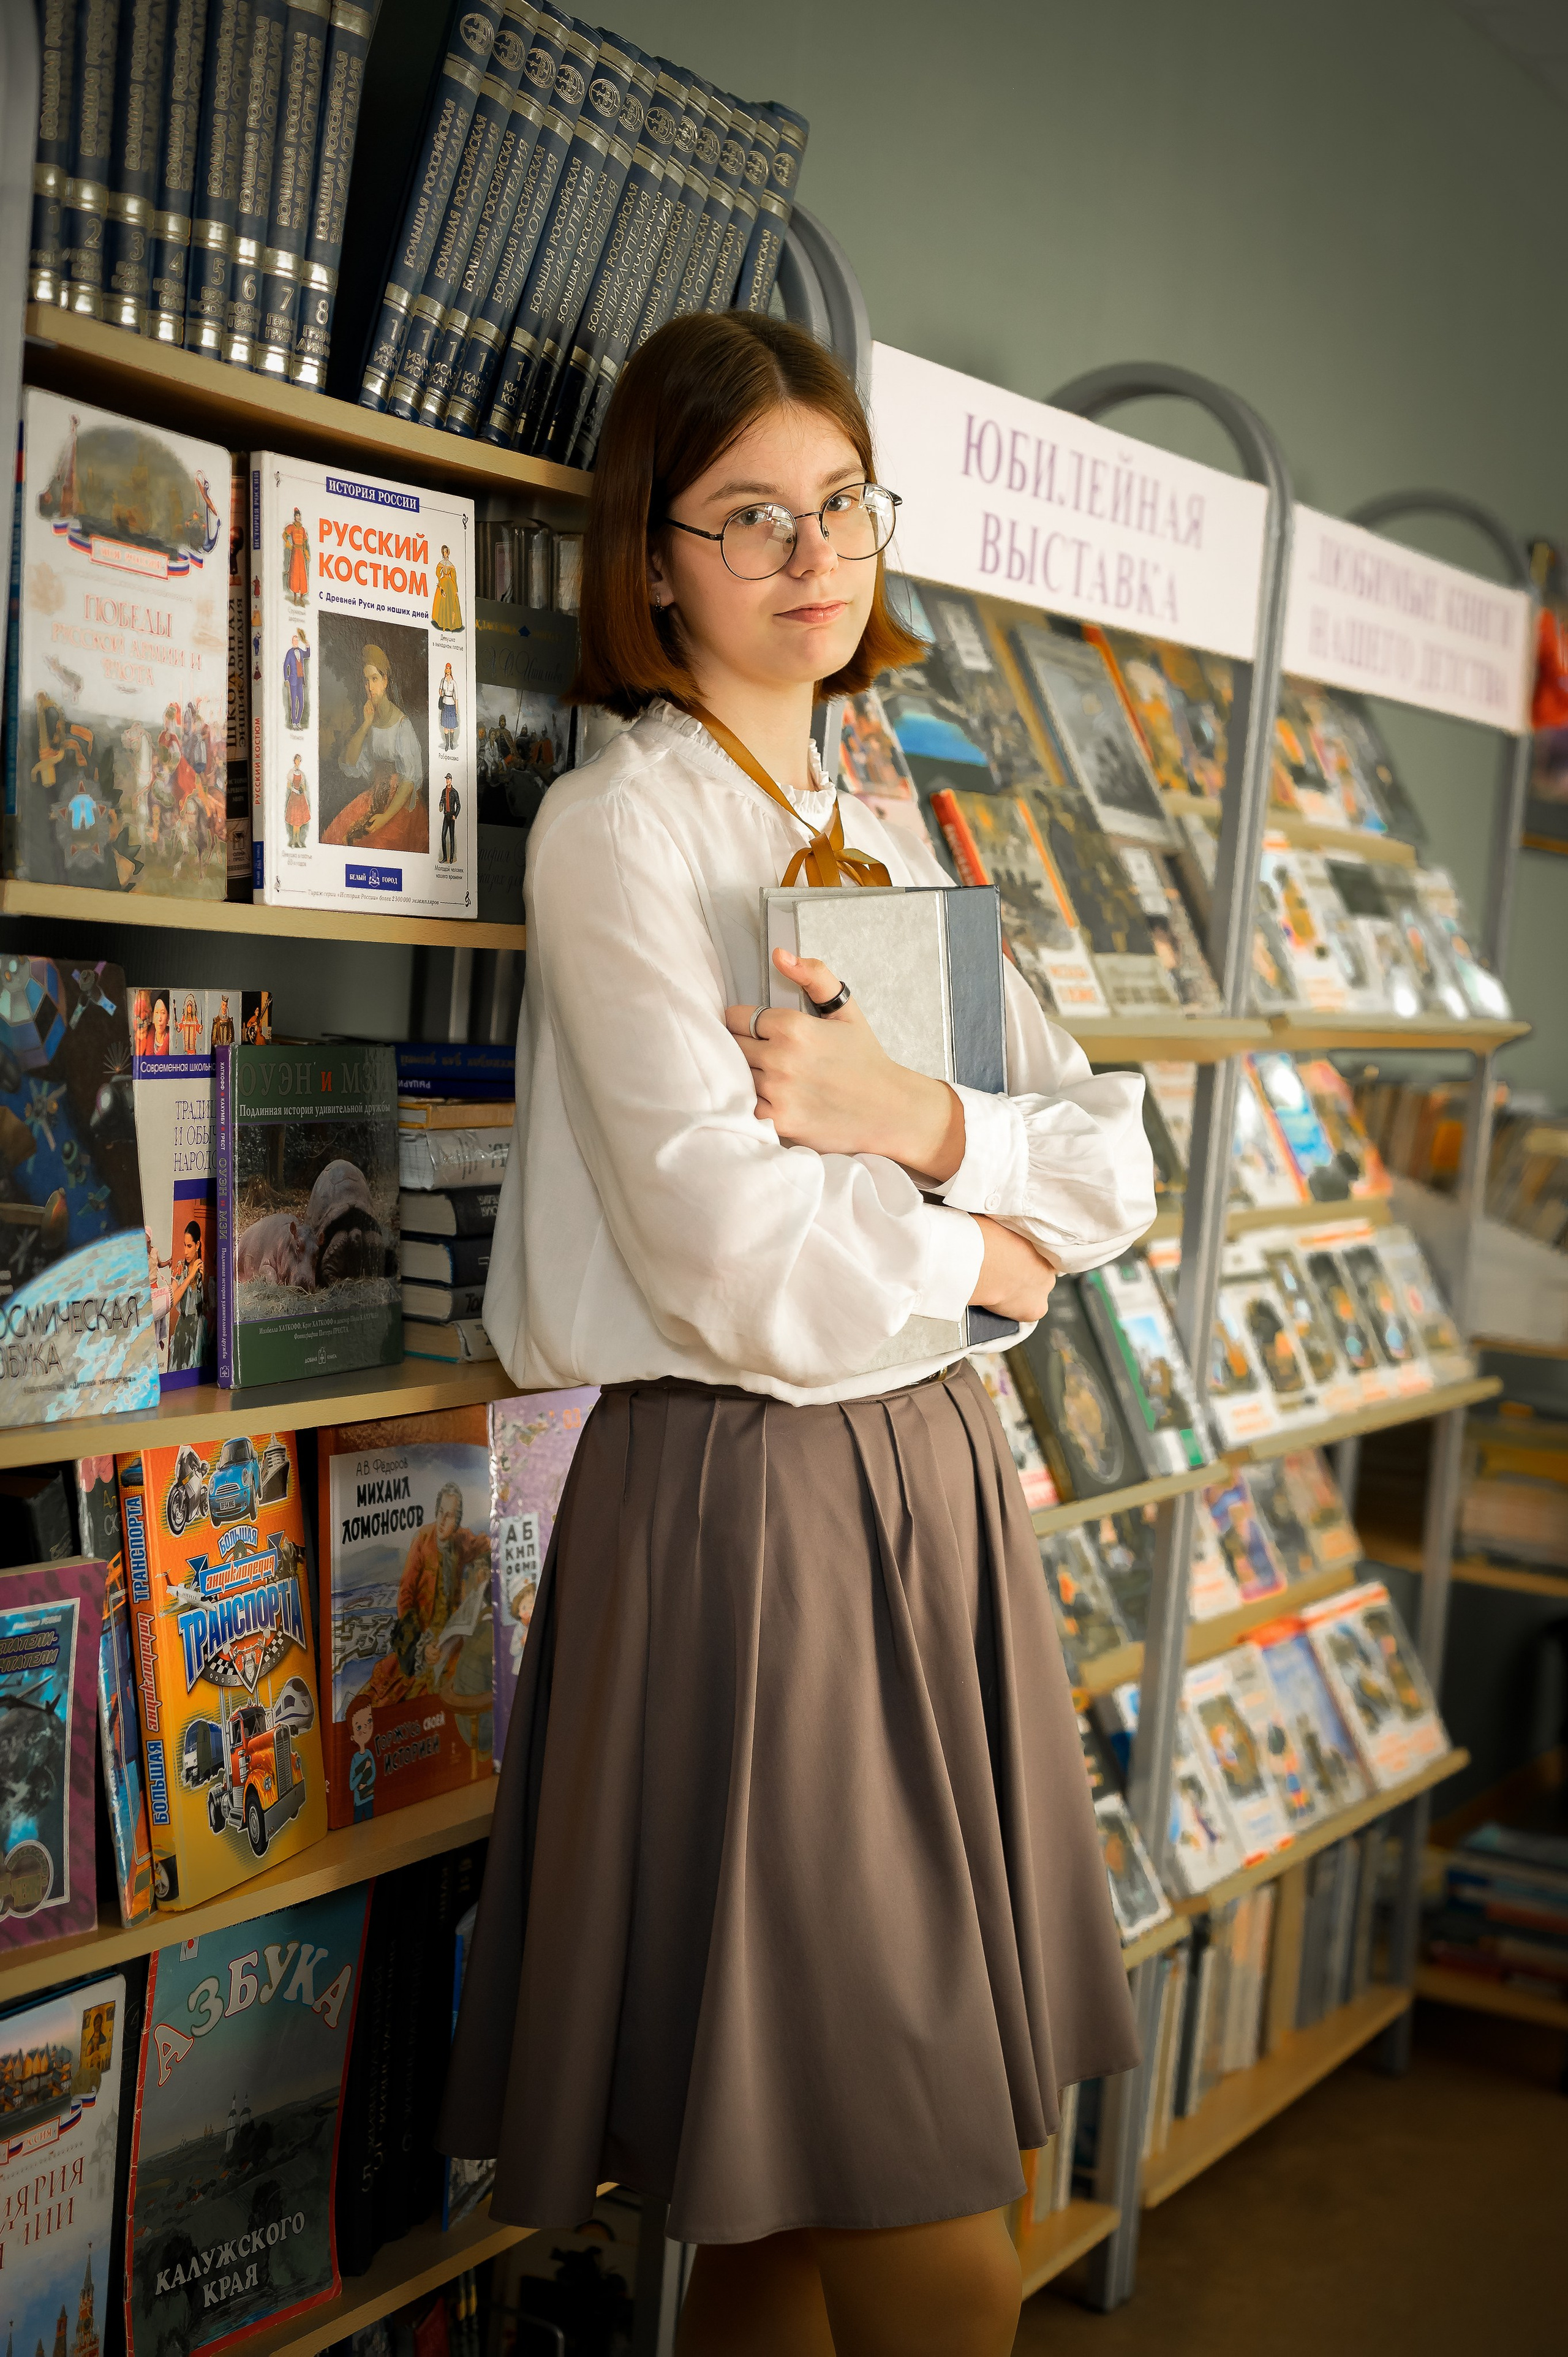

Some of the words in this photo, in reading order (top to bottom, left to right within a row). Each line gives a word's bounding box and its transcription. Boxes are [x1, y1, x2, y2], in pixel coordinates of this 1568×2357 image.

[247, 15, 270, 129] РОССИЙСКАЯ
[285, 31, 307, 143] РОССИЙСКАЯ
[208, 114, 227, 197] БОЛЬШАЯ
[239, 131, 258, 214] БОЛЬШАЯ
[292, 36, 323, 229] ЭНЦИКЛОПЕДИЯ
[315, 162, 335, 241] БОЛЬШАЯ
[325, 50, 349, 158] РОССИЙСКАЯ
[330, 56, 363, 244] ЭНЦИКЛОПЕДИЯ
[277, 146, 296, 227] БОЛЬШАЯ
[404, 195, 430, 268] БОЛЬШАЯ
[422, 98, 456, 195] РОССИЙСКАЯ
[434, 209, 461, 279] БОЛЬШАЯ
[453, 113, 487, 208] РОССИЙСКАЯ
[448, 121, 500, 286] ЭНЦИКЛОПЕДИЯ
[462, 223, 489, 292] БОЛЬШАЯ
[482, 129, 516, 222] РОССИЙСКАЯ
[475, 138, 530, 301] ЭНЦИКЛОПЕДИЯ
[492, 236, 518, 303] БОЛЬШАЯ
[512, 144, 545, 235] РОССИЙСКАЯ
[168, 251, 184, 279] 4
[211, 257, 225, 285] 5
[505, 151, 559, 314] ЭНЦИКЛОПЕДИЯ
[529, 247, 556, 314] БОЛЬШАЯ
[549, 156, 582, 246] РОССИЙСКАЯ
[541, 165, 595, 323] ЭНЦИКЛОПЕДИЯ
[557, 258, 582, 323] БОЛЬШАЯ
[576, 172, 608, 257] РОССИЙСКАЯ
[567, 179, 619, 334] ЭНЦИКЛОПЕДИЯ
[587, 269, 612, 333] БОЛЬШАЯ
[606, 181, 639, 268] РОССИЙСКАЯ
[598, 190, 651, 344] ЭНЦИКЛОПЕДИЯ
[619, 198, 674, 347] ЭНЦИКЛОПЕДИЯ
[637, 286, 662, 347] БОЛЬШАЯ
[655, 200, 686, 284] РОССИЙСКАЯ
[680, 212, 710, 294] РОССИЙСКАЯ
[708, 222, 737, 306] РОССИЙСКАЯ
[242, 274, 256, 301] 6
[280, 285, 294, 311] 7
[315, 298, 328, 325] 8
[421, 329, 440, 358] 11
[328, 480, 376, 500] ИСТОРИЯ
[378, 491, 417, 510] РОССИИ
[960, 412, 1208, 550] ЮБИЛЕЙНАЯ
[318, 518, 428, 565] РУССКИЙ
[318, 551, 429, 598] КОСТЮМ
[978, 511, 1179, 623] ВЫСТАВКА
[84, 594, 172, 637] ПОБЕДЫ
[319, 590, 324, 599] С
[325, 592, 356, 605] Древней
[358, 598, 375, 608] Руси
[376, 602, 385, 612] до
[387, 605, 411, 616] наших
[412, 609, 429, 619] дней
[227, 598, 236, 748] ШКОЛЬНАЯ
[349, 873, 366, 881] БЕЛЫЙ
[382, 877, 398, 885] ГОРОД
[140, 1061, 188, 1075] Современная
[238, 1062, 312, 1096] ОУЭН
[174, 1127, 183, 1146] И
[239, 1104, 282, 1119] Подлинная
[283, 1106, 314, 1118] история
[315, 1102, 363, 1118] удивительной
[218, 1158, 228, 1196] ОУЭН
[219, 1210, 228, 1240] МЗИ
[356, 1476, 412, 1508] МИХАИЛ
[372, 1456, 409, 1475] Фёдоров
[125, 1495, 151, 1604] ТРАНСПОРТА
[219, 1525, 258, 1557] БОЛЬШАЯ
[341, 1504, 424, 1545] ЛОМОНОСОВ
[177, 1575, 308, 1694] ТРАНСПОРТА
[374, 1719, 421, 1758] ГОРЖУСЬ
[383, 1731, 441, 1776] ИСТОРИЕЙ
[147, 1740, 170, 1826] БОЛЬШАЯ
[153, 1940, 353, 2088] АЗБУКА
[154, 2211, 306, 2296] КАЛУЖСКОГО
[203, 2262, 259, 2308] КРАЯ
